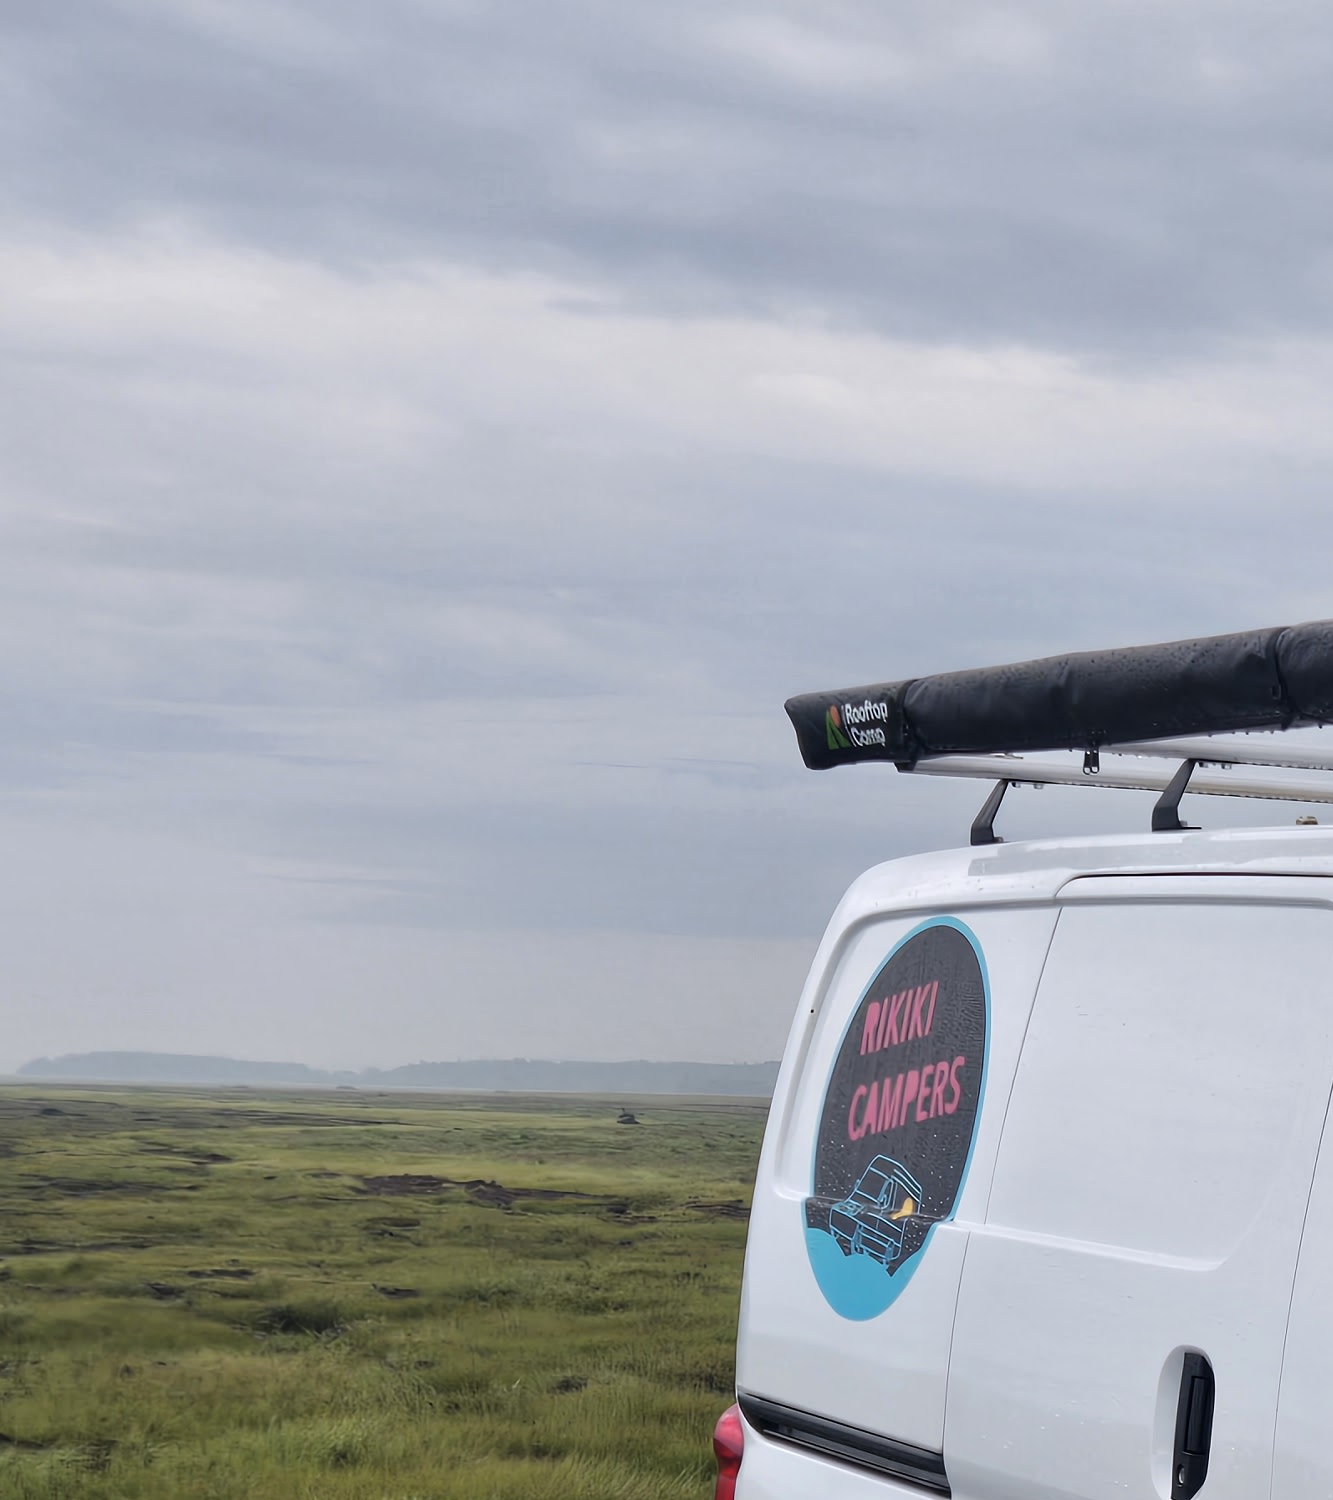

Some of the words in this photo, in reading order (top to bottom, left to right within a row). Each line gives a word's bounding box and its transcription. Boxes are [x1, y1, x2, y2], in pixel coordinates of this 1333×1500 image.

[845, 699, 888, 724] Rooftop
[860, 981, 939, 1055] RIKIKI
[848, 1056, 965, 1141] CAMPERS
